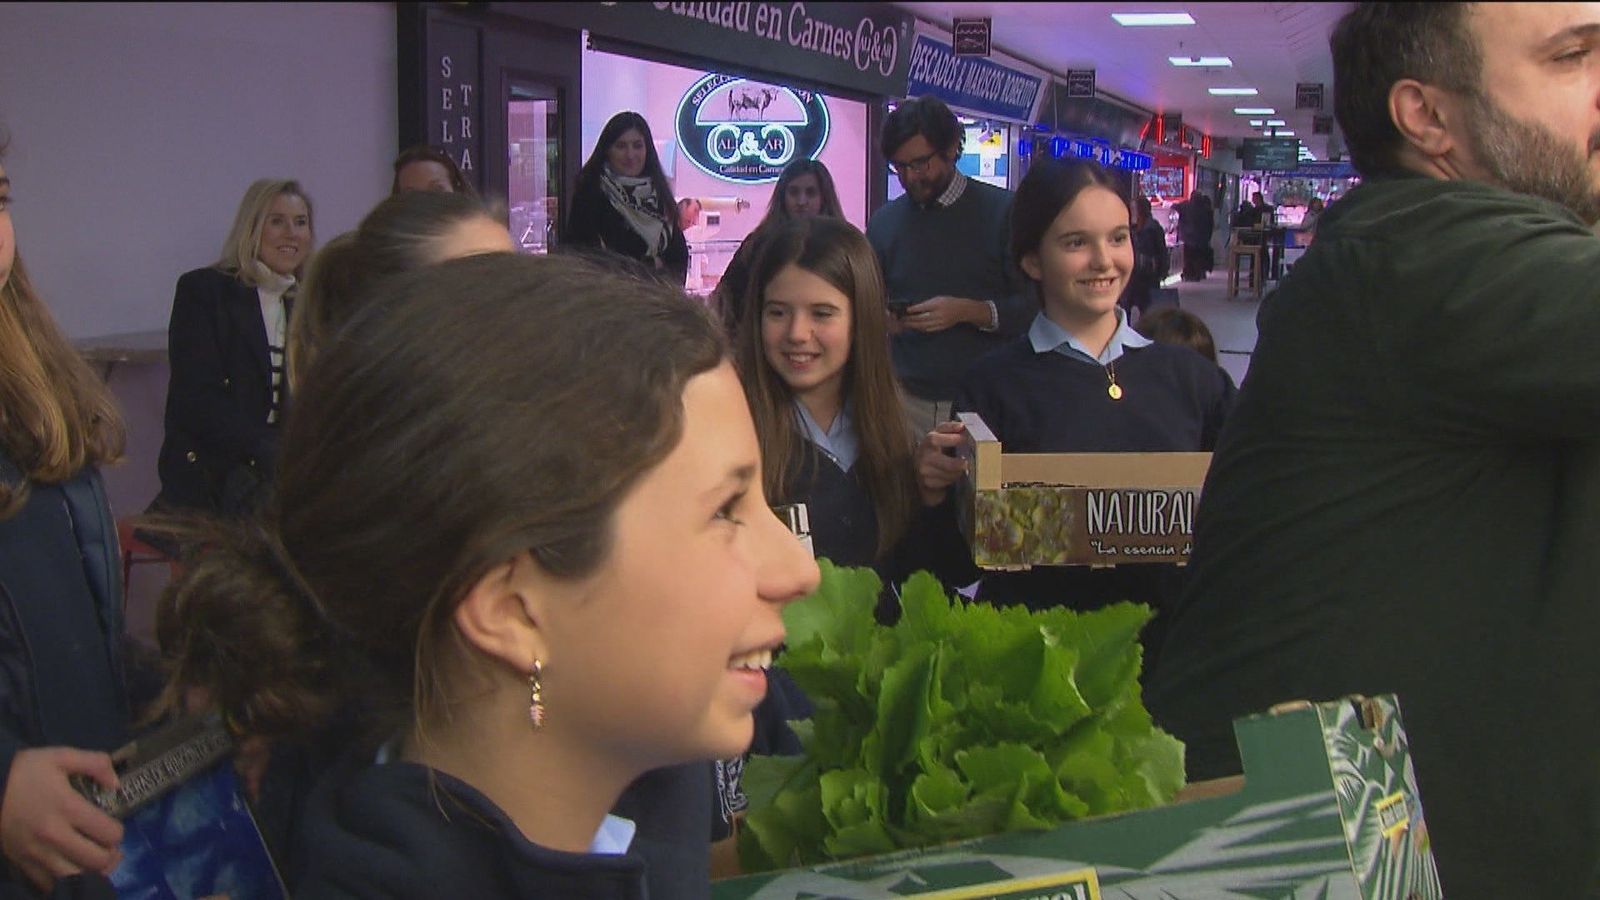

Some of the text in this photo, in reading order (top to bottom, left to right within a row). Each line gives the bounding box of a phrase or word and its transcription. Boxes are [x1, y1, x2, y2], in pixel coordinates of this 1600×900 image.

[653, 2, 852, 60] aidad en Carnes
[692, 75, 731, 106] SELECC
[908, 42, 960, 90] PESCADOS
[962, 61, 1005, 101] MARISCOS
[441, 55, 454, 154] SEL
[460, 84, 472, 170] TRA
[765, 138, 783, 150] AR
[720, 165, 748, 174] Calidad
[1124, 546, 1175, 555] esencia
[1181, 543, 1192, 554] d
